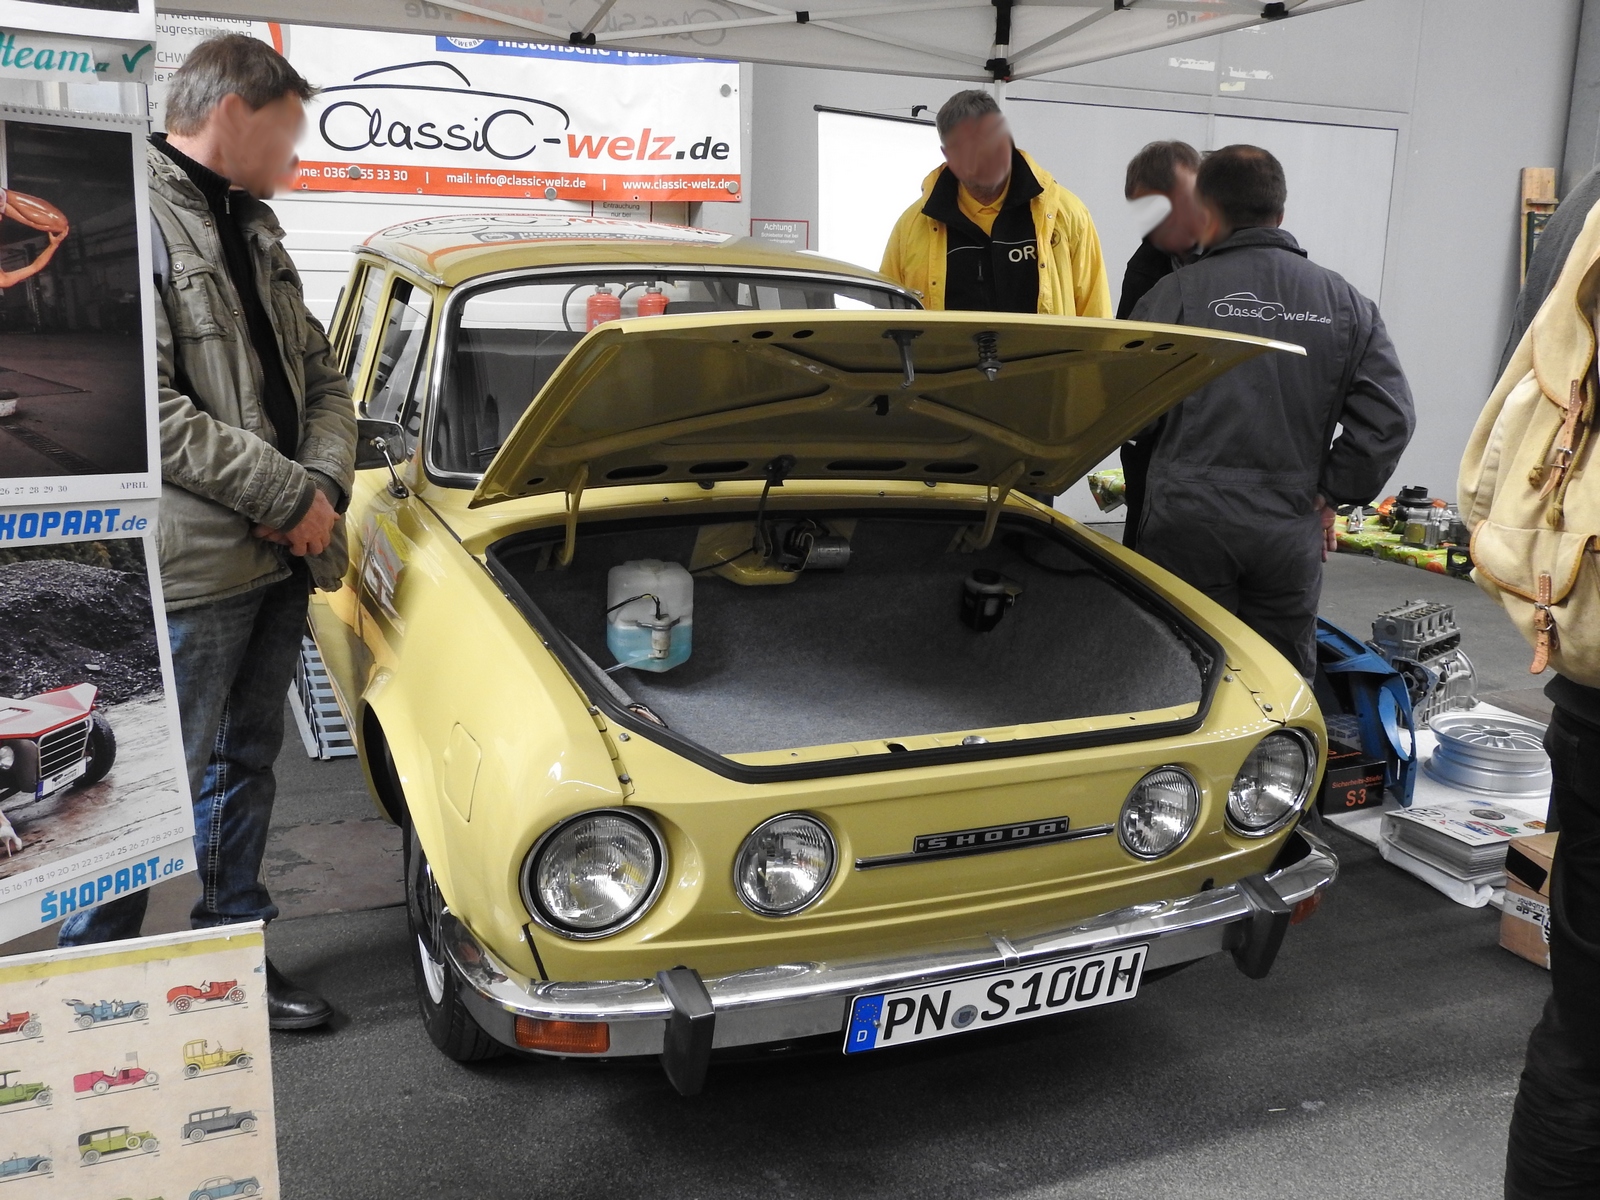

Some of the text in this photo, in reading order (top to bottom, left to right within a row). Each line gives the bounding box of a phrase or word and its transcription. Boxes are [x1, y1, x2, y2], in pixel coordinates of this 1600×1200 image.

[376, 170, 391, 180] 33
[393, 170, 408, 181] 30
[446, 173, 586, 188] mail: info@classic-welz.de
[29, 486, 39, 494] 28
[43, 485, 54, 493] 29
[120, 482, 149, 490] APRIL
[41, 856, 184, 923] ŠKOPART.de
[857, 1029, 867, 1042] D
[883, 990, 951, 1040] PN
